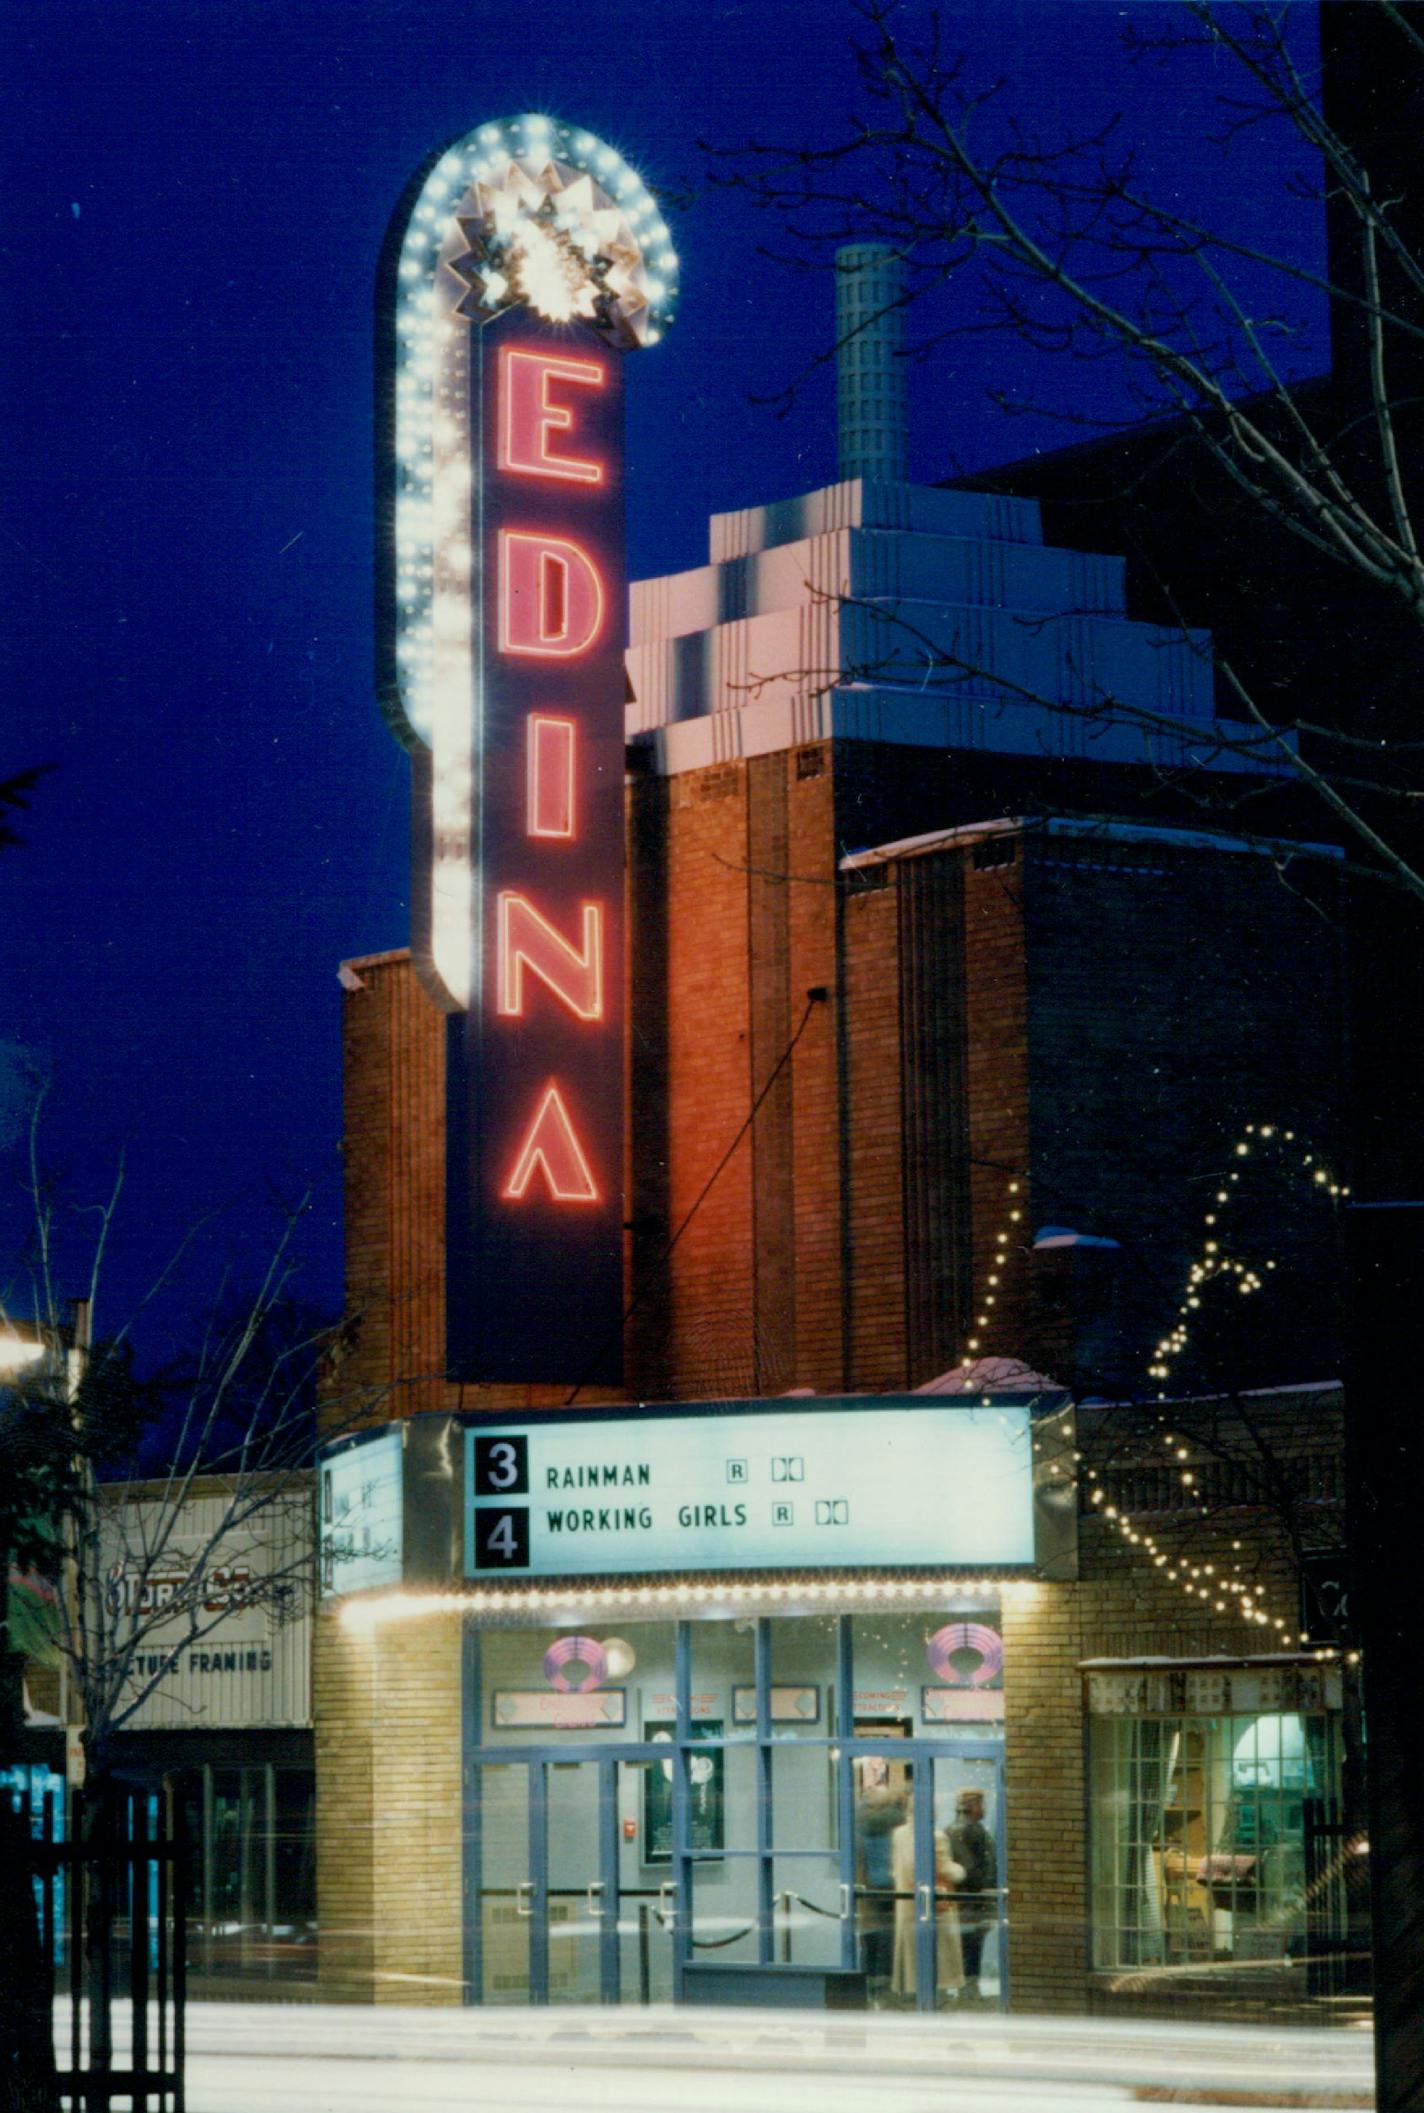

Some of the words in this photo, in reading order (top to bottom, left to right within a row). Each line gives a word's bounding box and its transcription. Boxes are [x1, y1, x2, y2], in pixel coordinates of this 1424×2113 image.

[498, 345, 604, 1200] EDINA
[487, 1443, 518, 1488] 3
[546, 1464, 650, 1489] RAINMAN
[486, 1514, 518, 1559] 4
[546, 1507, 651, 1533] WORKING
[678, 1505, 747, 1528] GIRLS
[189, 1650, 272, 1673] FRAMING
